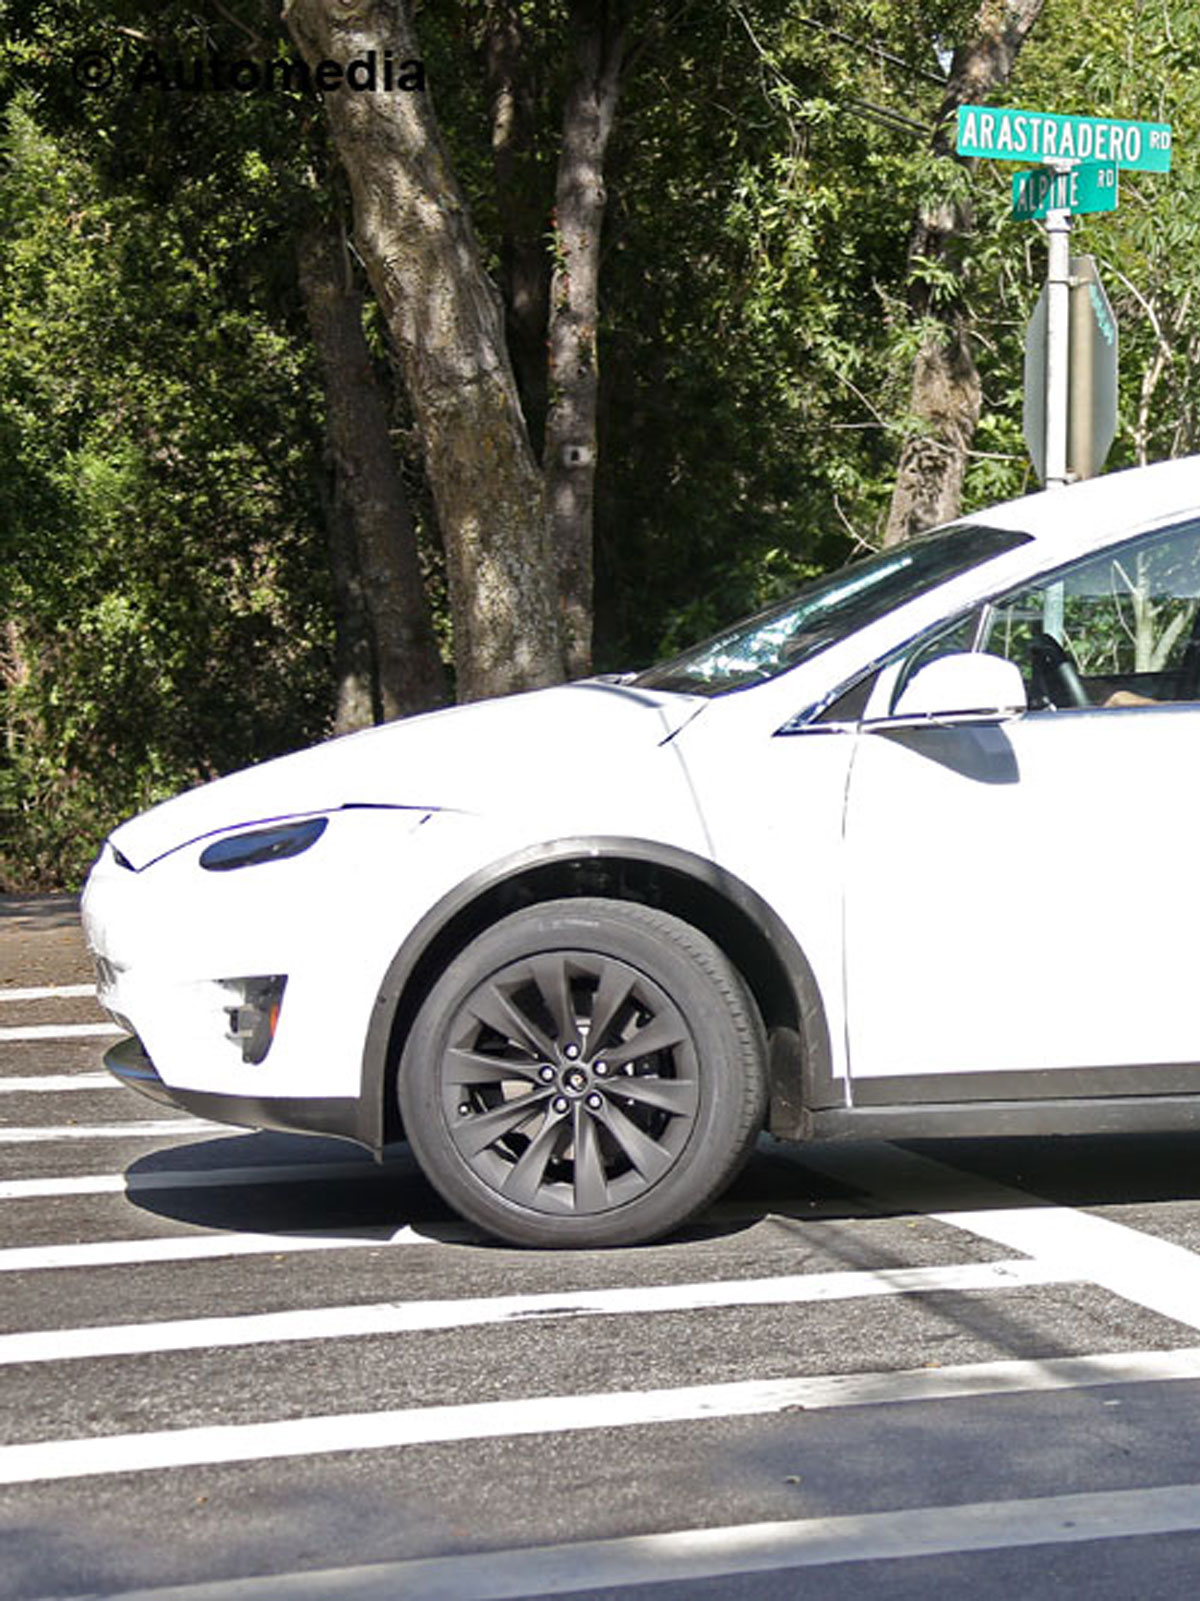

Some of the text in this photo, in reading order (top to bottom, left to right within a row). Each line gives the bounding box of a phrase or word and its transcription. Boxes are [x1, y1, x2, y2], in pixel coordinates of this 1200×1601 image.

[961, 112, 1171, 162] ARASTRADERO RD
[1017, 169, 1114, 212] ALPINE RD
